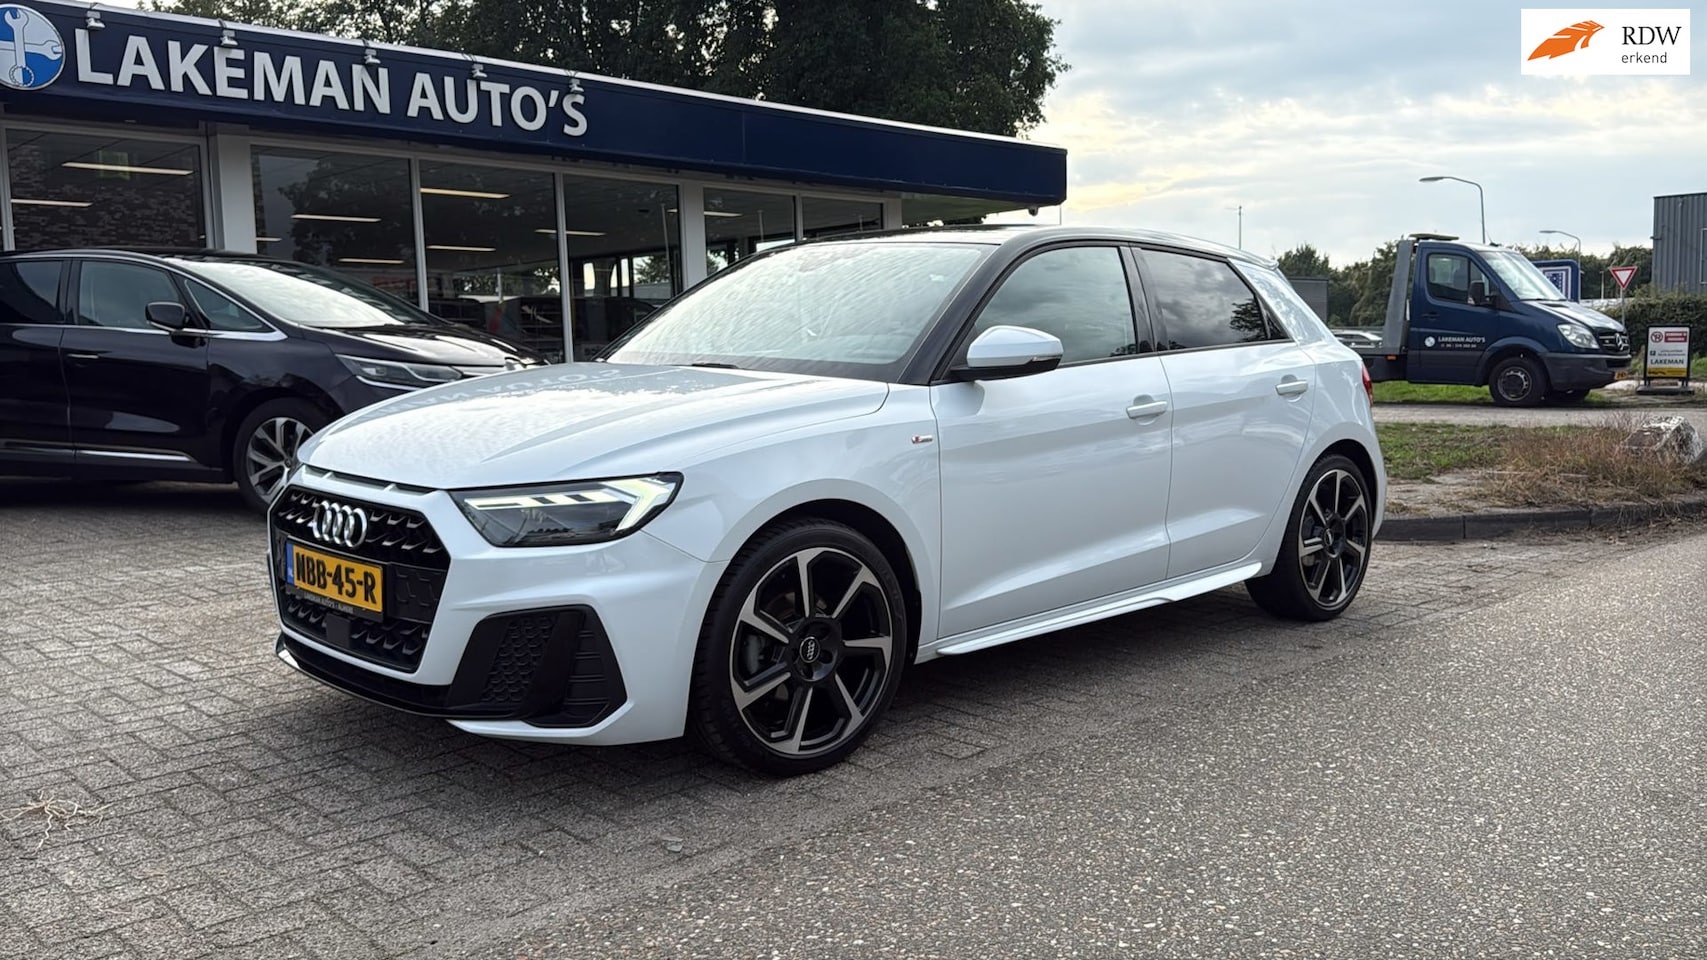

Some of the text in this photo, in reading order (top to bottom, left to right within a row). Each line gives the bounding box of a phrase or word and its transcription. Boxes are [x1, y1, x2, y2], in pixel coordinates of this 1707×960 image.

[75, 28, 588, 137] LAKEMAN AUTO'S
[295, 552, 377, 605] NBB-45-R
